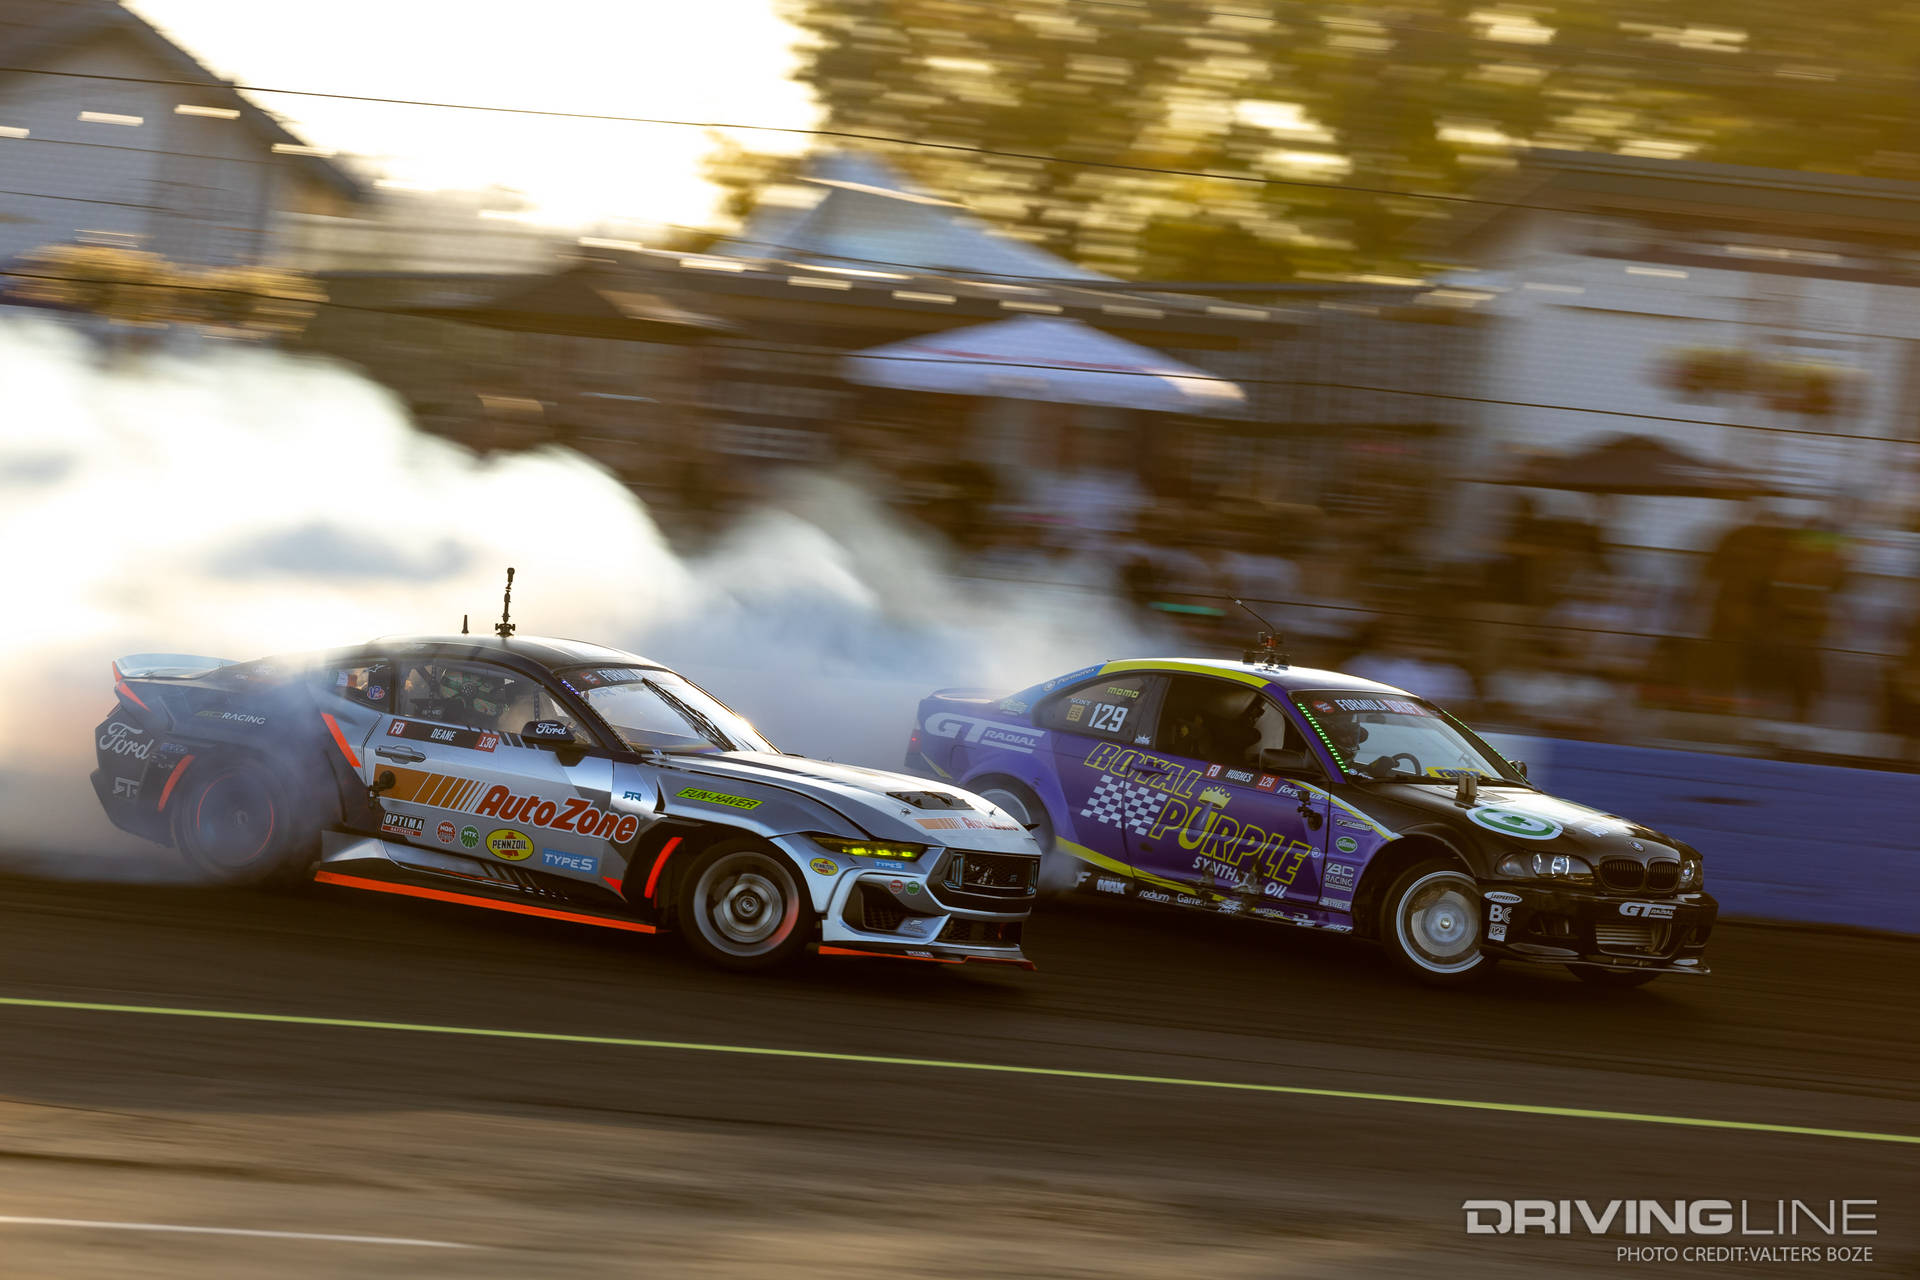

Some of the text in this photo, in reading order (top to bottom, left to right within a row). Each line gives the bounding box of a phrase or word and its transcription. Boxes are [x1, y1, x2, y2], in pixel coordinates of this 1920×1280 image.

[1106, 686, 1140, 698] momo
[1334, 699, 1389, 712] FORMULA
[222, 711, 267, 730] RACING
[1088, 702, 1128, 732] 129
[390, 722, 497, 749] FD DEANE 130
[535, 722, 567, 737] Ford
[924, 712, 1045, 747] GT RADIAL
[99, 722, 154, 760] Ford
[1084, 742, 1203, 799] ROYAL
[1206, 764, 1276, 788] FD HUGHES 129
[680, 788, 759, 810] FUN-HAVER
[385, 813, 423, 830] OPTIMA
[475, 784, 640, 844] AutoZone
[492, 838, 528, 850] PENNZOIL
[1148, 797, 1313, 886] PURPLE
[1264, 881, 1288, 900] OIL
[1325, 874, 1353, 887] RACING
[1619, 901, 1677, 919] GT
